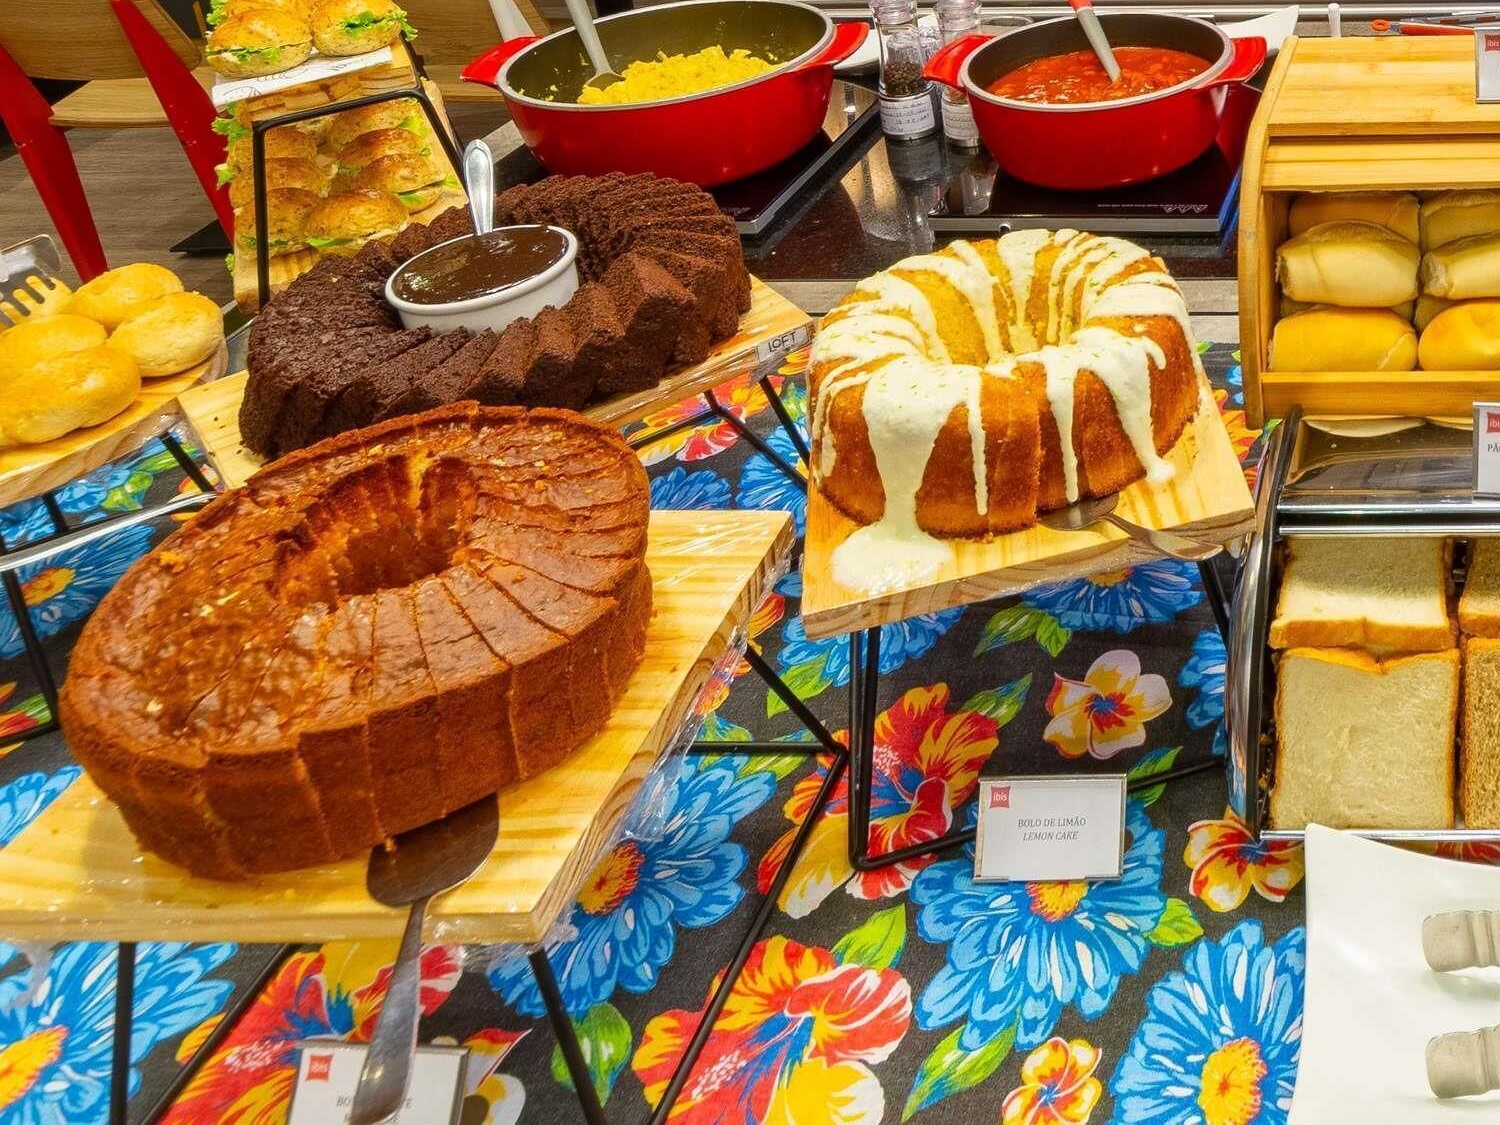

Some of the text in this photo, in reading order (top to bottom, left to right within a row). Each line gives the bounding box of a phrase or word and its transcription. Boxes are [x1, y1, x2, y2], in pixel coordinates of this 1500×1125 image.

[1488, 39, 1500, 47] ibis
[768, 331, 796, 353] LOFT
[993, 791, 1008, 801] ibis
[1018, 816, 1087, 828] BOLO DE LIMÃO
[1023, 831, 1079, 841] LEMON CAKE
